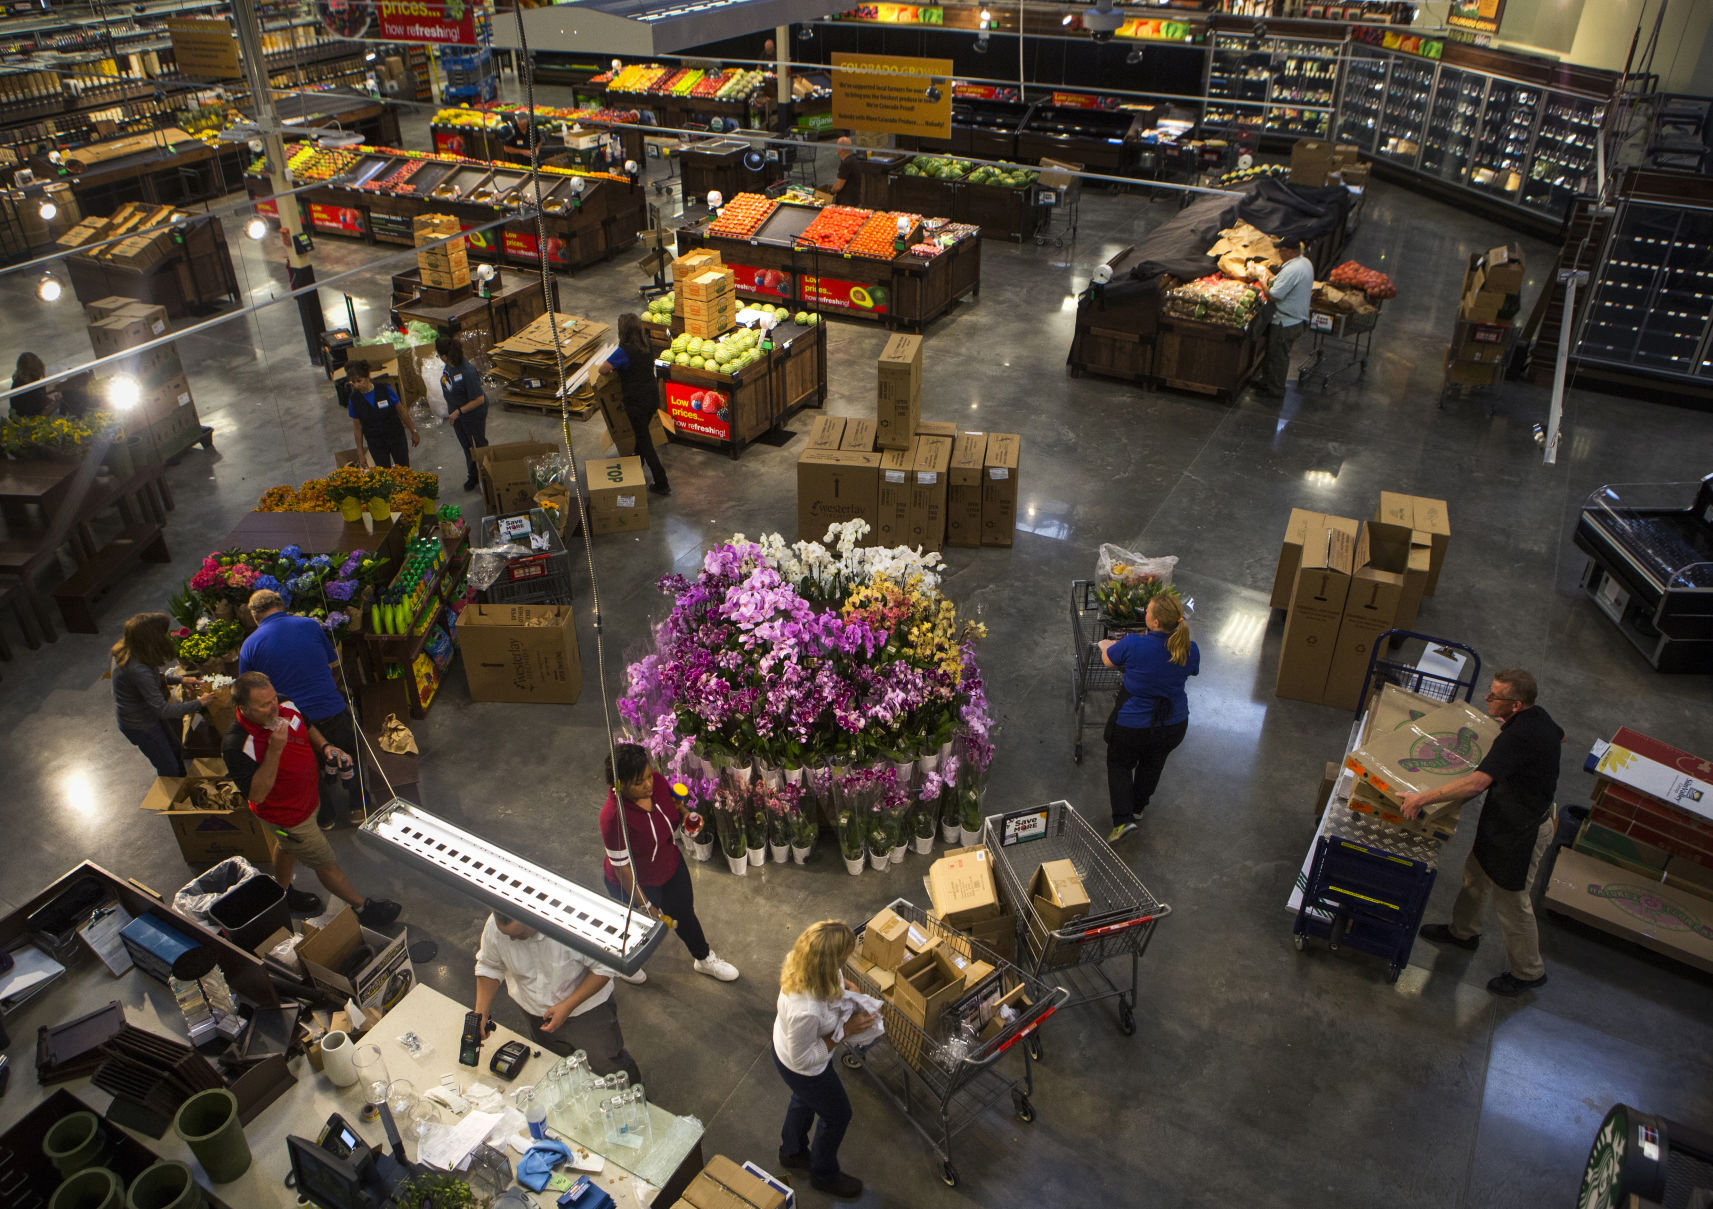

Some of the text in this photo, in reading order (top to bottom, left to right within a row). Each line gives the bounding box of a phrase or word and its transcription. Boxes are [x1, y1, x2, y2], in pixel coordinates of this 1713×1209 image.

[382, 0, 441, 18] prices...
[1449, 15, 1497, 32] COLORADO GROWN
[384, 22, 461, 42] how refreshing!
[840, 62, 898, 76] COLORADO
[887, 85, 905, 93] farmers
[311, 203, 323, 212] Low
[504, 230, 517, 239] Low
[506, 240, 529, 249] prices...
[671, 395, 689, 408] Low
[672, 408, 705, 422] prices...
[687, 422, 726, 438] refreshing!
[606, 463, 624, 483] TOP
[820, 503, 866, 515] westerlay
[505, 519, 523, 527] Save
[507, 638, 528, 683] westerlay
[1013, 822, 1038, 833] MORE
[1015, 817, 1038, 826] Save
